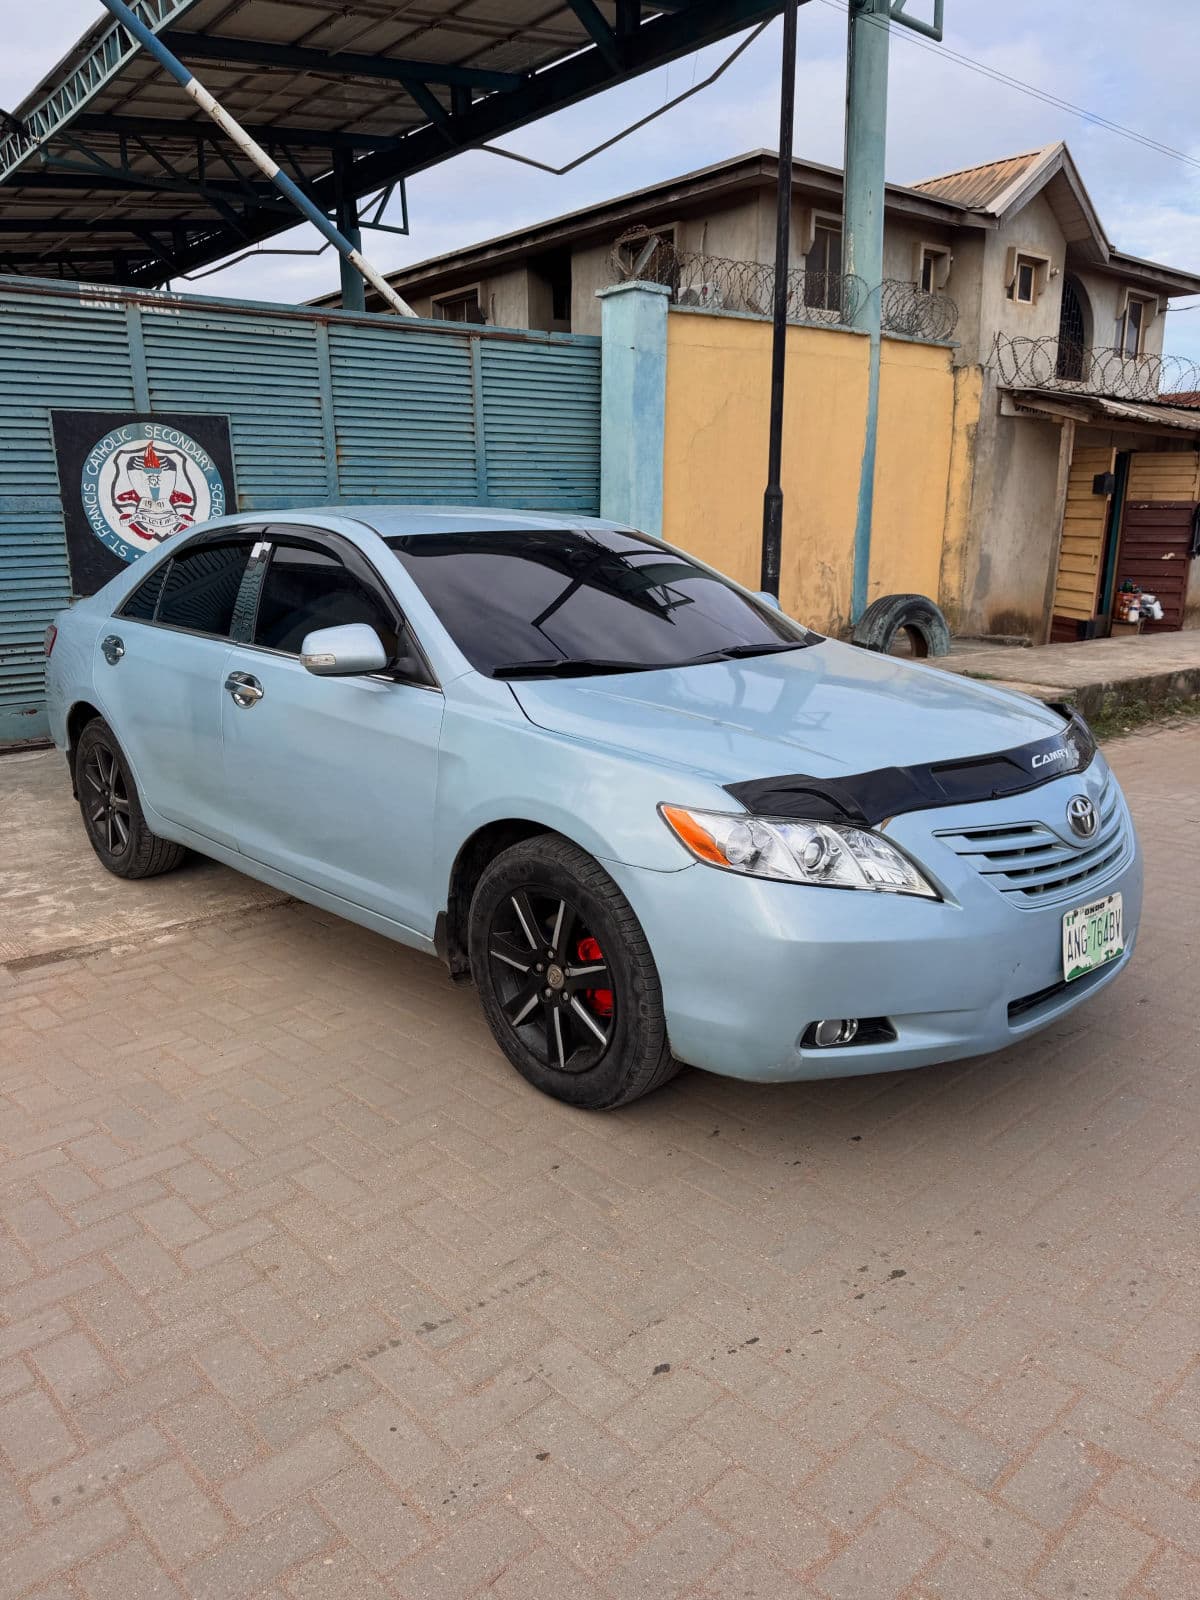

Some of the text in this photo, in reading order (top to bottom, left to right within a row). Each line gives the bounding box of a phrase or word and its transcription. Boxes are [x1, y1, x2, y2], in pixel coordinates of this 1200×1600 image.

[86, 428, 132, 476] CATHOLIC
[144, 425, 215, 472] SECONDARY
[1031, 748, 1069, 768] CAMRY
[1084, 902, 1105, 915] ONDO
